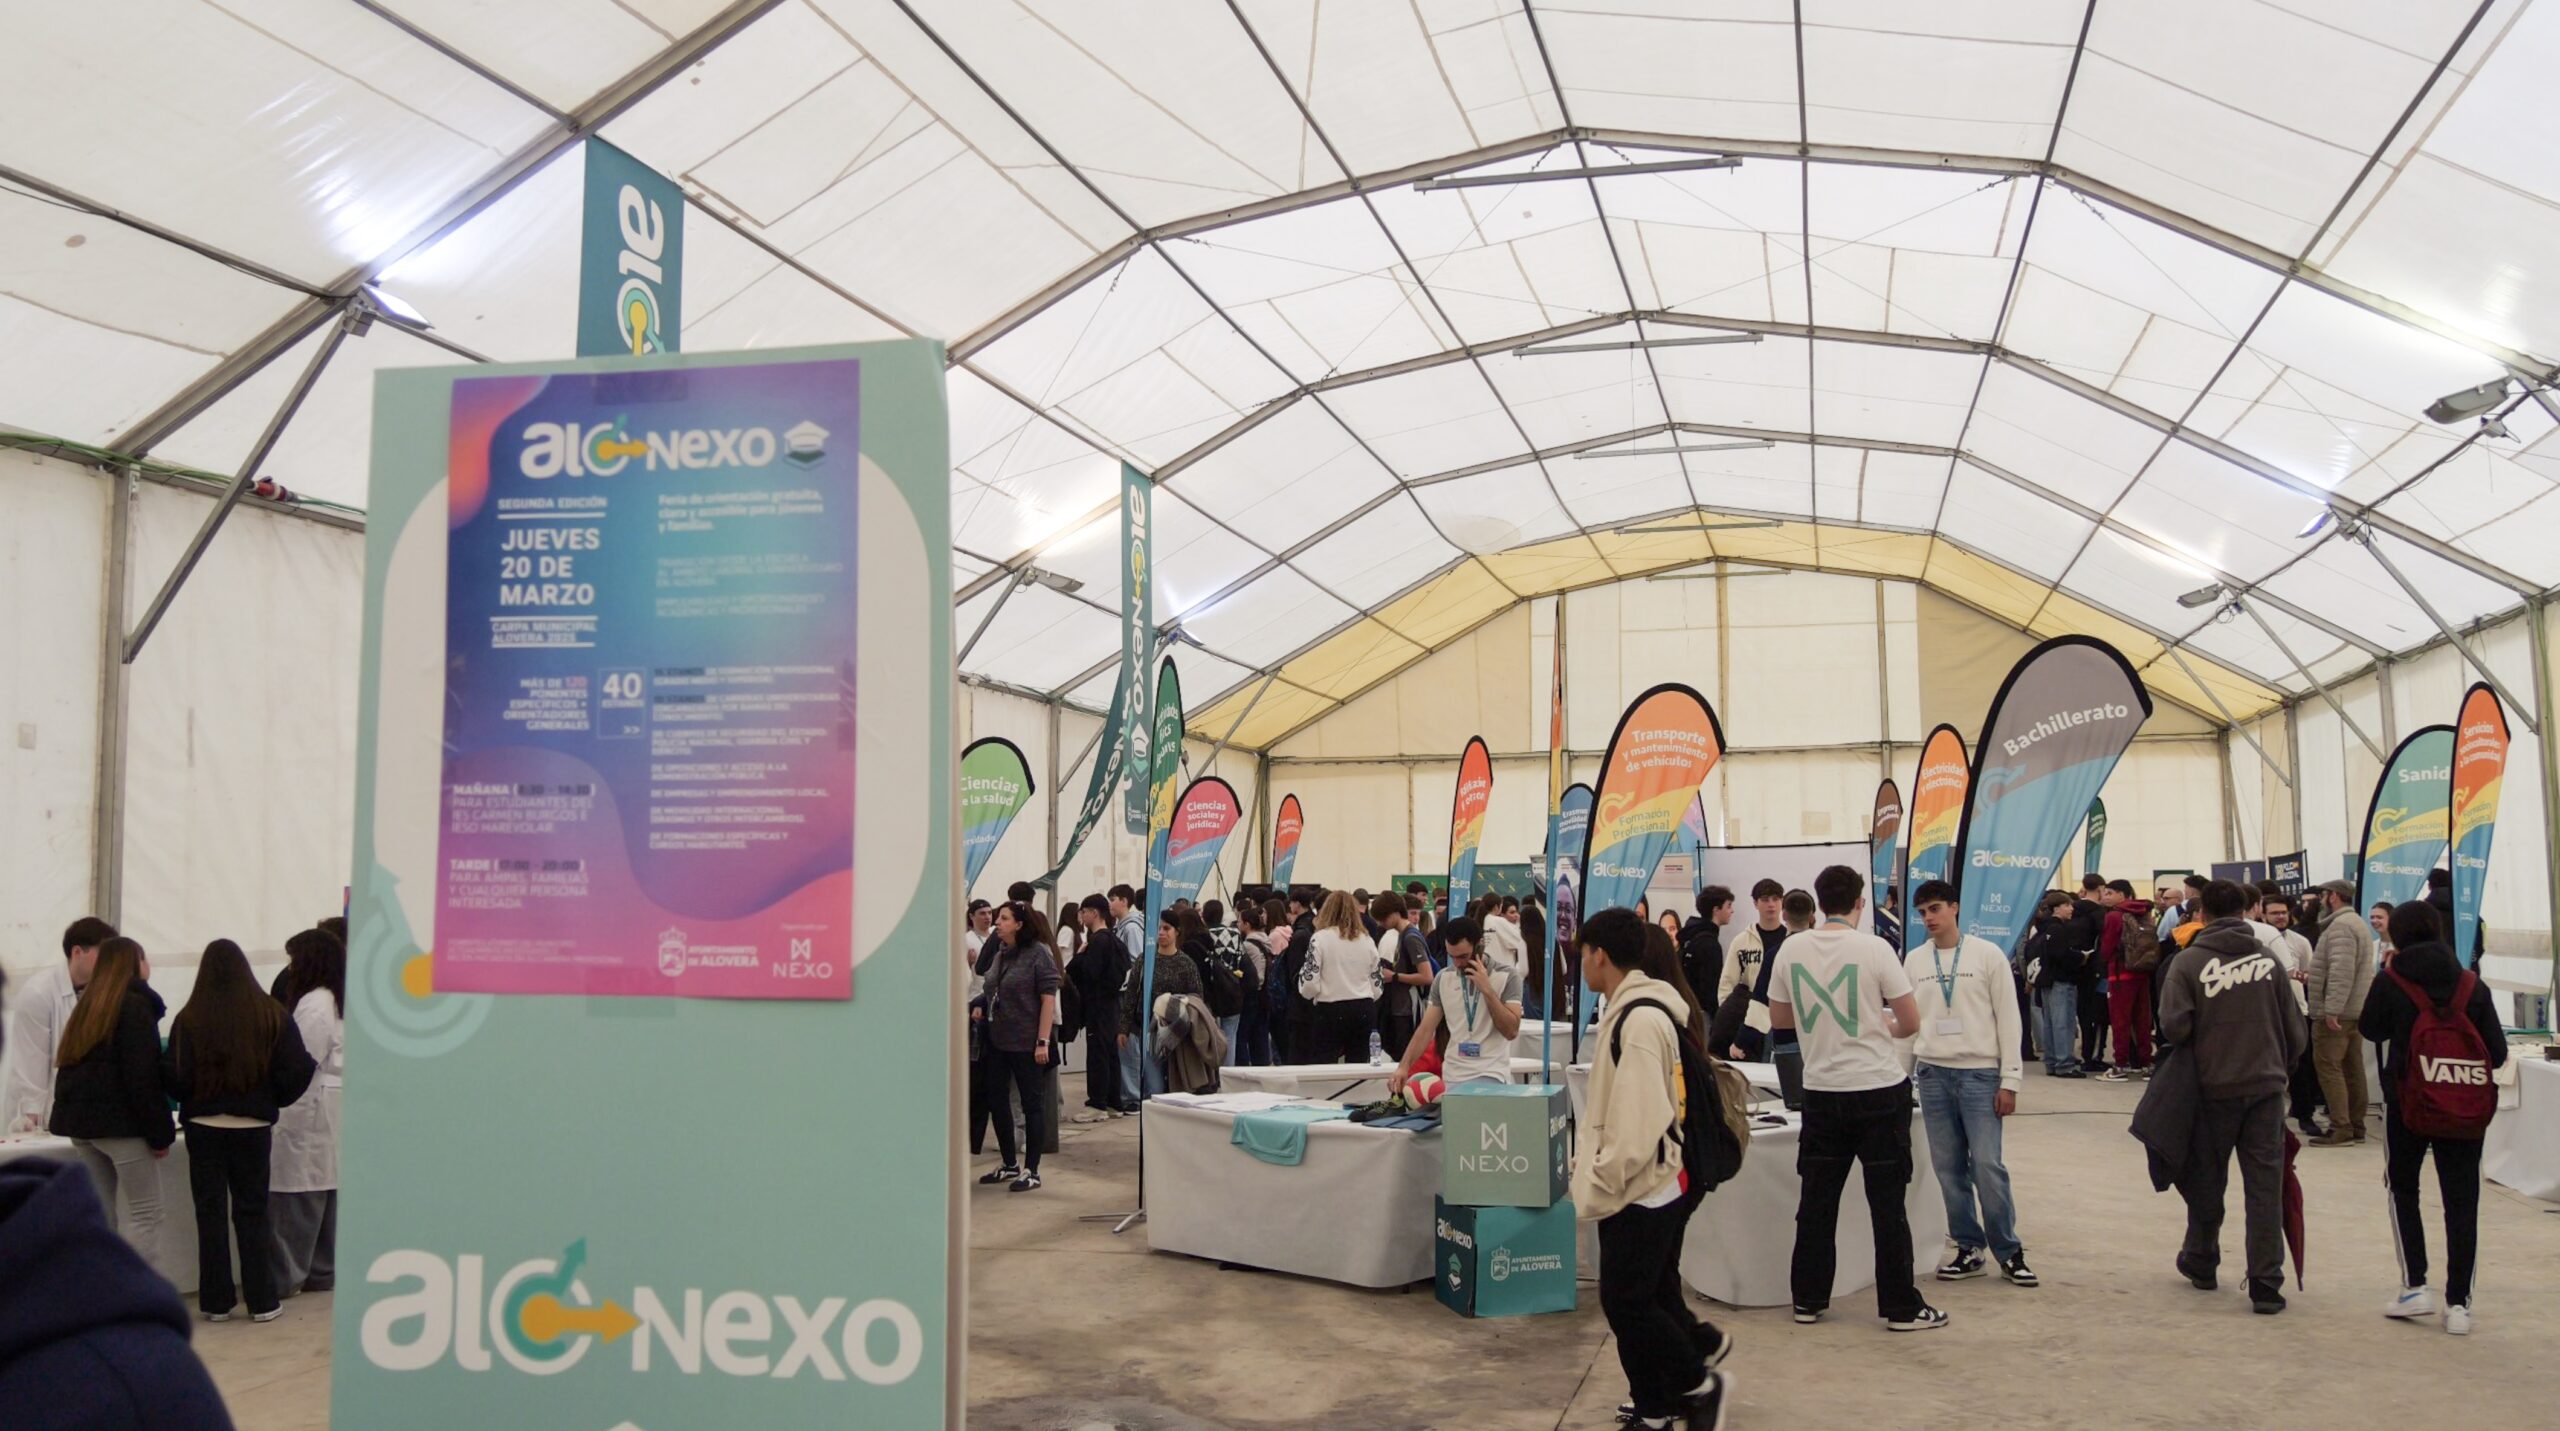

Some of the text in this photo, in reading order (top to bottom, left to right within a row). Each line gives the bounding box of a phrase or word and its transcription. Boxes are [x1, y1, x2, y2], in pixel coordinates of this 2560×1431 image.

[497, 495, 608, 510] SEGUNDA EDICIÓN
[501, 528, 600, 550] JUEVES
[501, 556, 573, 578] 20 DE
[500, 584, 595, 606] MARZO
[492, 622, 597, 632] CARPA MUNICIPAL
[492, 633, 544, 643] ALOVERA
[520, 677, 544, 688] MÁS
[547, 678, 562, 688] DE
[603, 673, 642, 698] 40
[530, 689, 588, 699] PONENTES
[510, 699, 578, 709] ESPECÍFICOS
[503, 710, 587, 720] ORIENTADORES
[526, 721, 590, 731] GENERALES
[2003, 703, 2129, 757] Bachillerato
[2464, 721, 2494, 739] Servicios
[1631, 730, 1707, 746] Transporte
[1622, 744, 1708, 761] y mantenimiento
[1626, 754, 1693, 773] de vehículos
[1922, 764, 1965, 780] Electricidad
[2399, 766, 2450, 783] Sanid
[452, 782, 510, 795] MAÑANA
[452, 798, 483, 808] PARA
[486, 797, 567, 808] ESTUDIANTES
[970, 795, 981, 805] la
[982, 793, 1015, 807] salud
[1187, 801, 1226, 811] Ciencias
[452, 810, 470, 820] IES
[472, 809, 523, 820] CARMEN
[1187, 811, 1225, 822] sociales y
[1187, 820, 1220, 831] jurídicas
[2393, 821, 2444, 834] Formación
[2388, 830, 2444, 845] Profesional
[450, 859, 490, 871] TARDE
[450, 872, 480, 883] PARA
[531, 872, 589, 883] FAMILIAS
[449, 885, 456, 895] Y
[530, 885, 588, 896] PERSONA
[1980, 904, 2012, 913] NEXO
[688, 945, 758, 956] AYUNTAMIENTO
[701, 954, 760, 967] ALOVERA
[773, 962, 833, 979] NEXO
[2419, 1055, 2488, 1085] VANS
[1459, 1155, 1529, 1173] NEXO
[1511, 1254, 1561, 1263] AYUNTAMIENTO
[1520, 1261, 1562, 1272] ALOVERA
